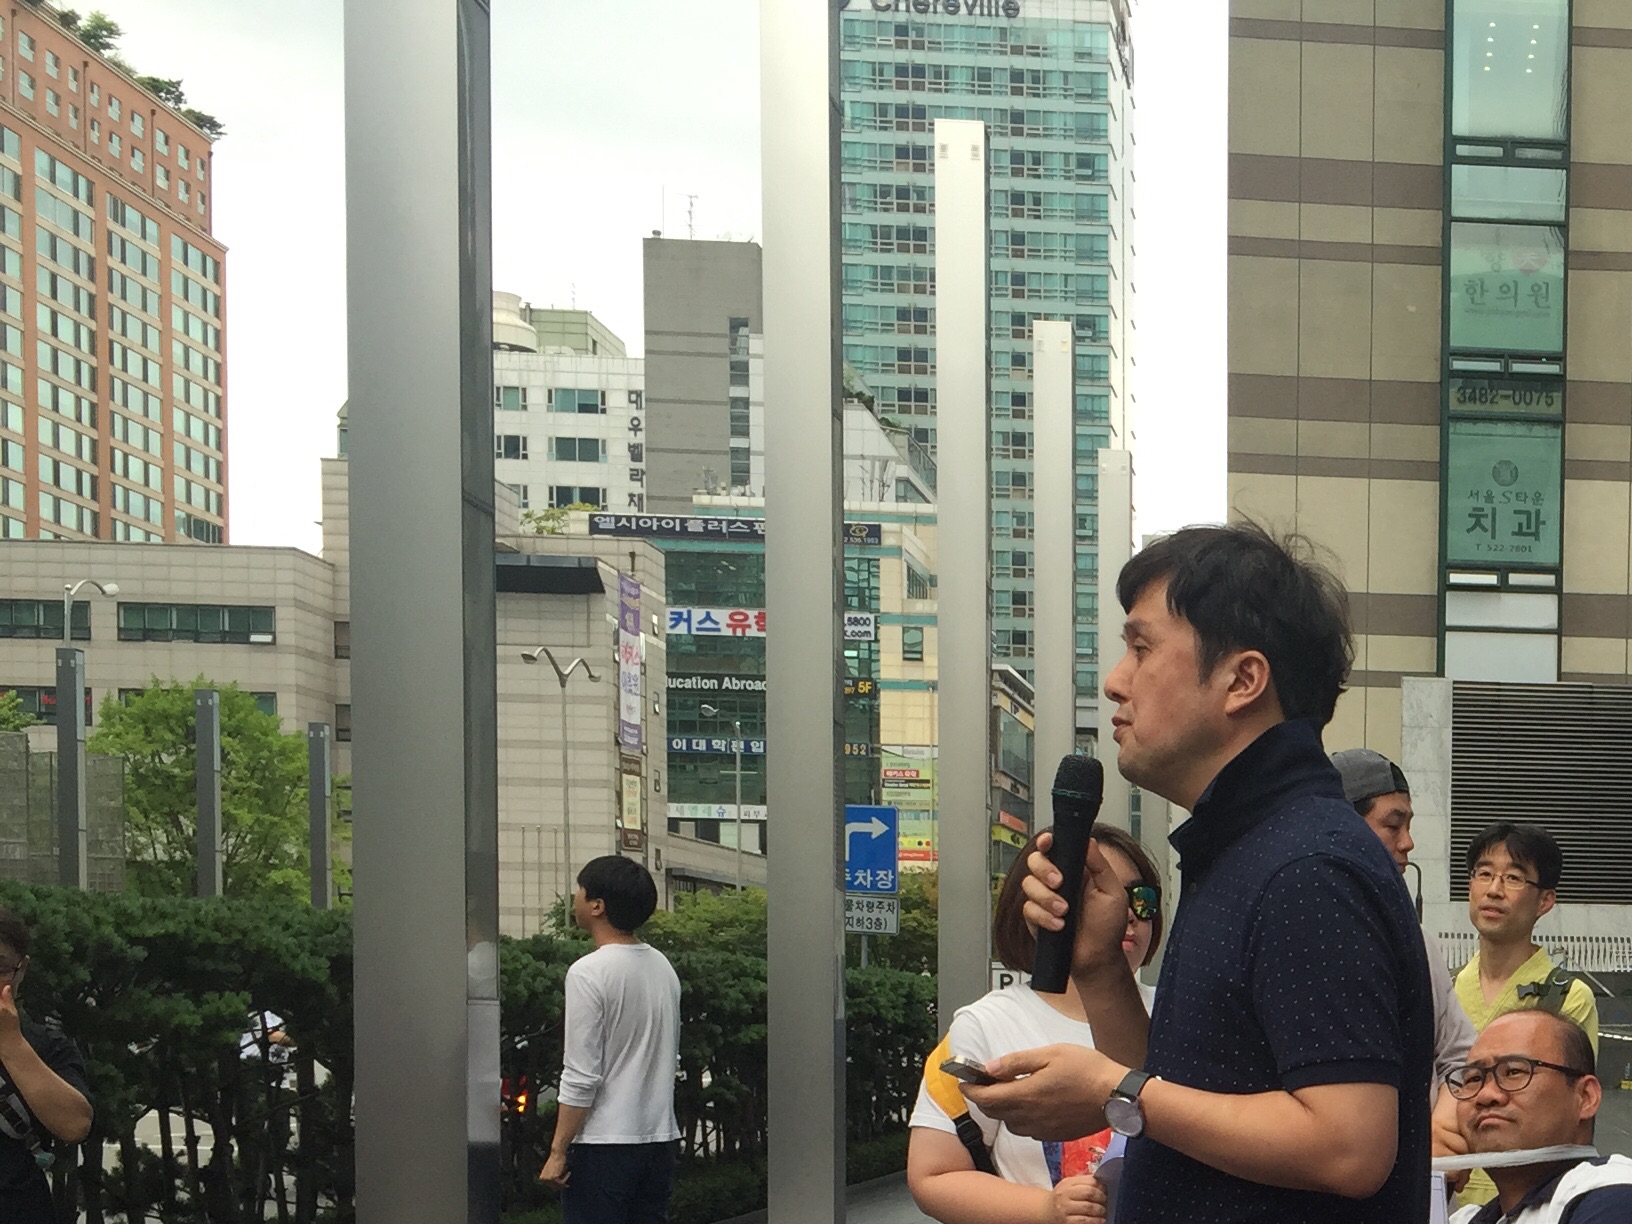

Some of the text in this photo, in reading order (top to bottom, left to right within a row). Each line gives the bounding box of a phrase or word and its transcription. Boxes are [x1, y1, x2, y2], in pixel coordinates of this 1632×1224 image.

[1456, 385, 1555, 408] 3482-0075
[1465, 506, 1547, 542] 치과
[666, 676, 719, 691] ucation
[857, 681, 872, 694] 5F
